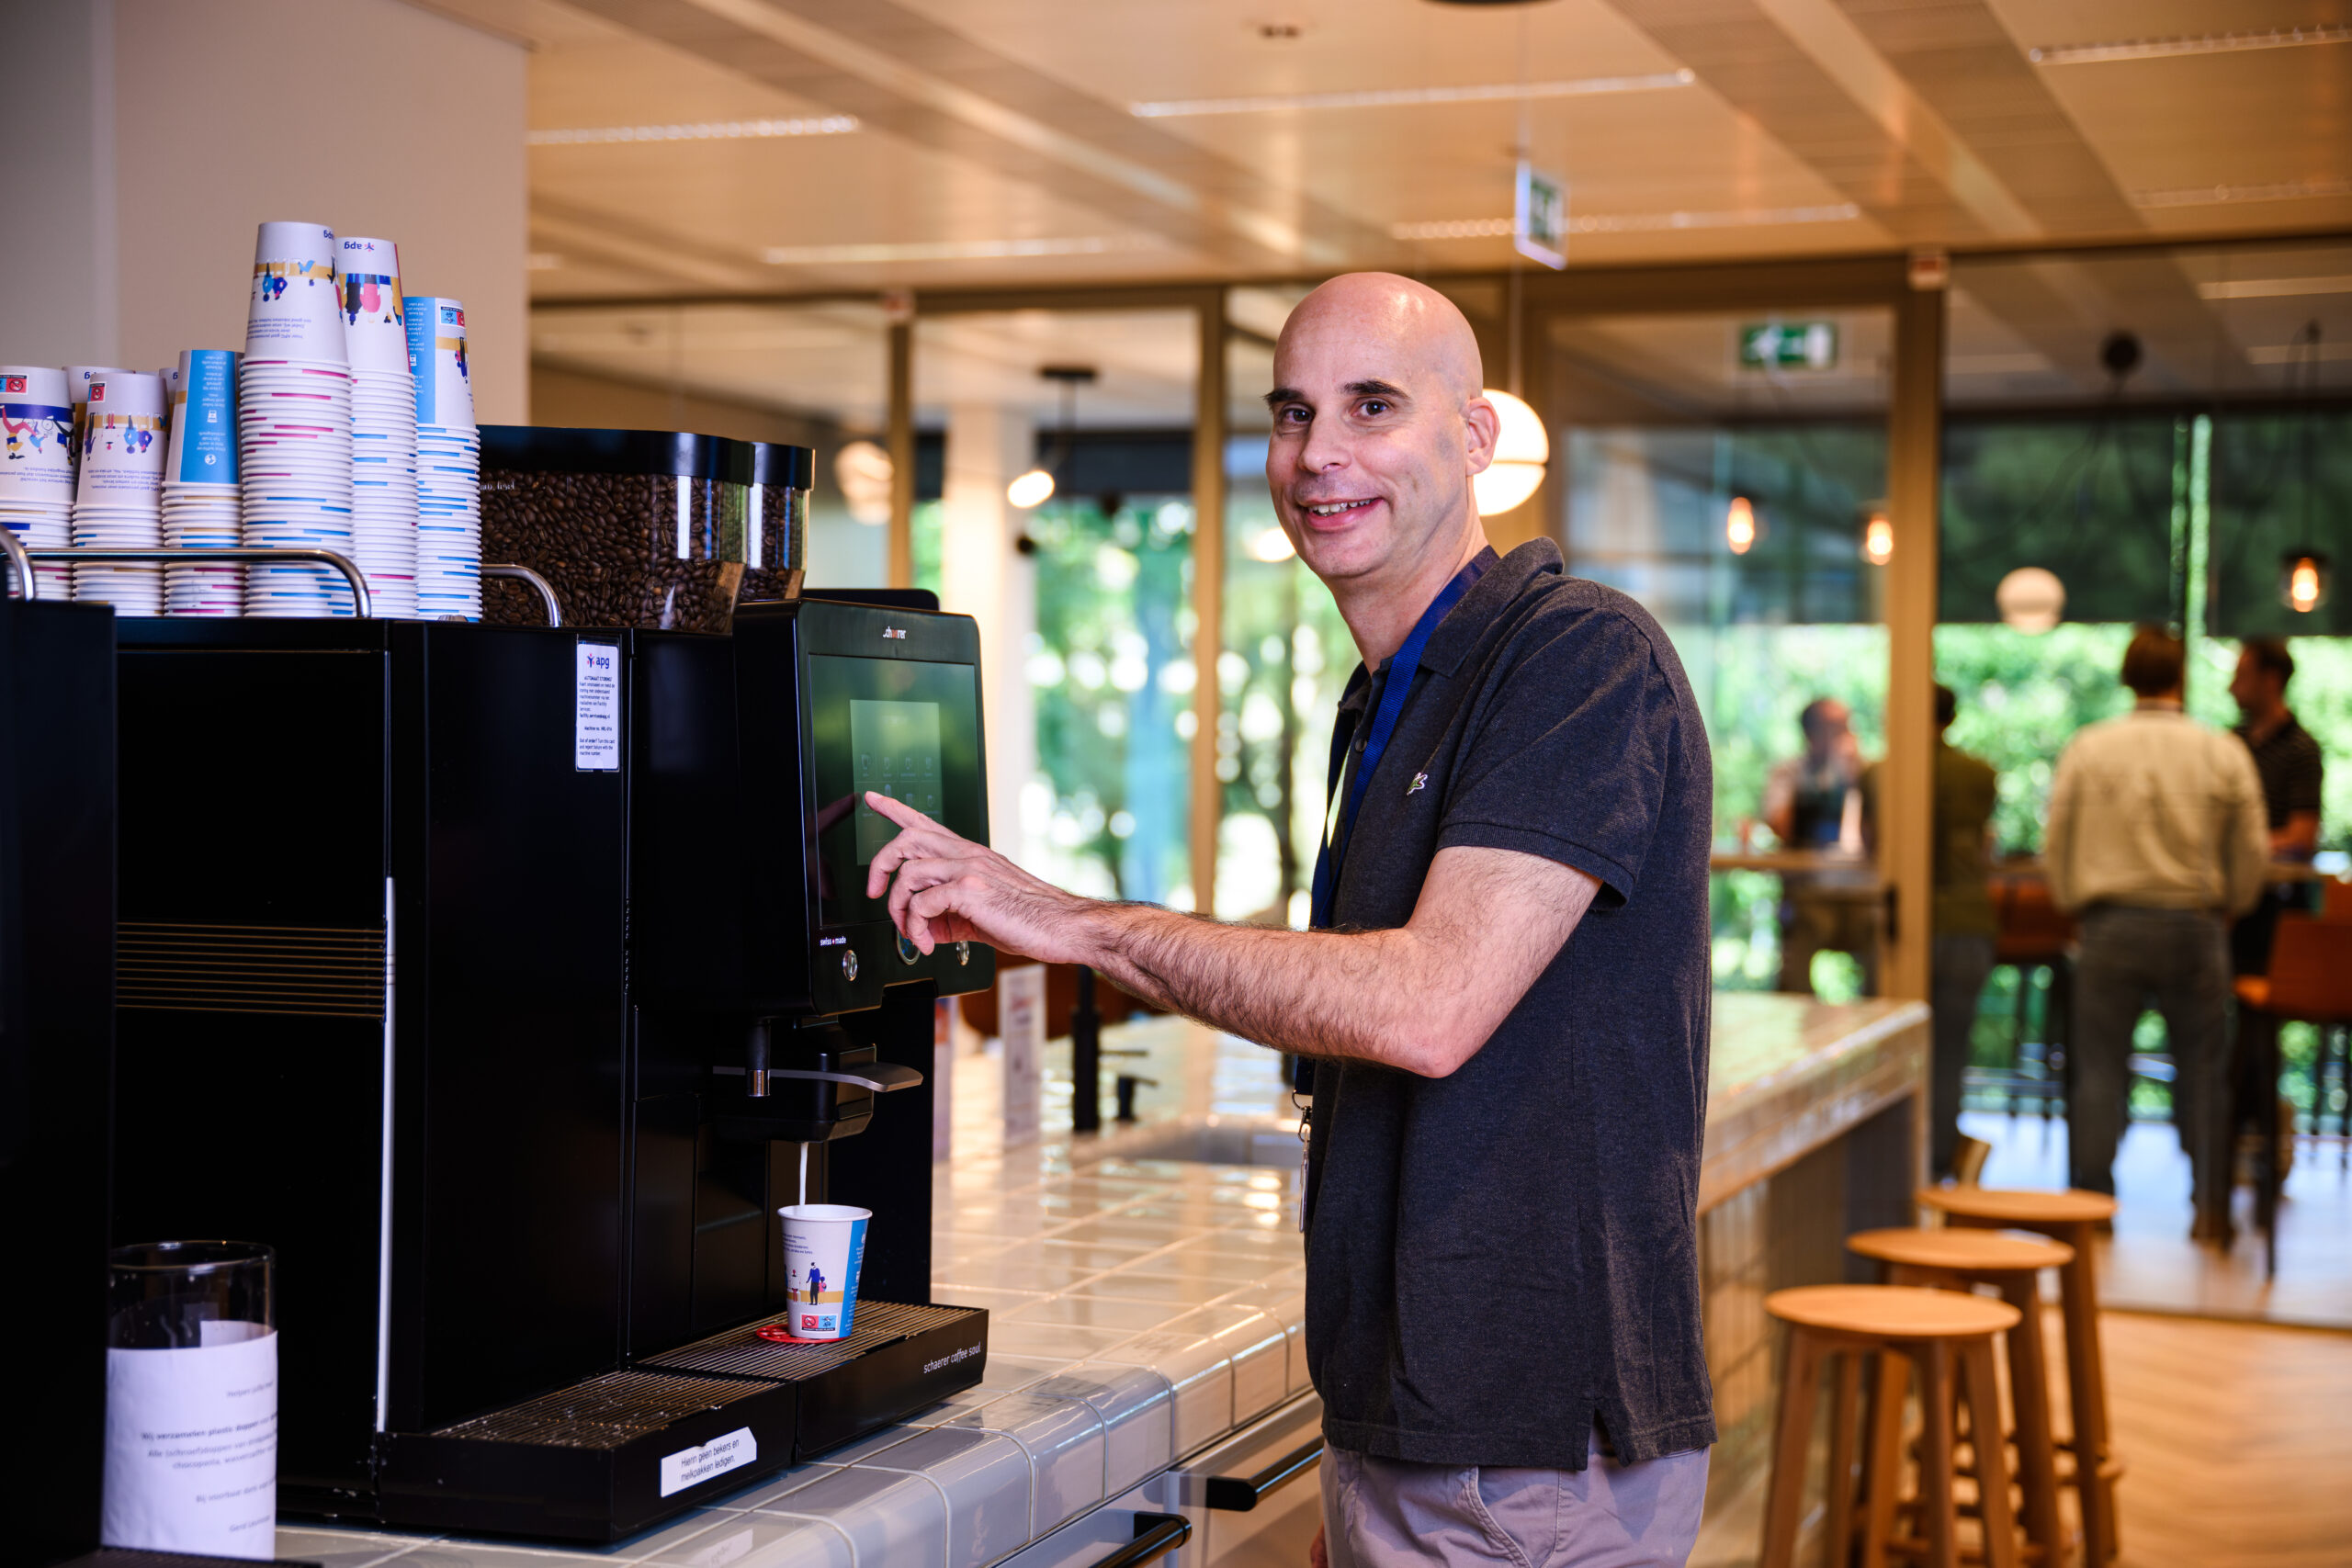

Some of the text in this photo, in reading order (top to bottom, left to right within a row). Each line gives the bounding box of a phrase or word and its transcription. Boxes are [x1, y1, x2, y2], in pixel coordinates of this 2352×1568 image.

[344, 241, 362, 250] apg
[596, 656, 610, 669] apg
[820, 936, 847, 946] swiss made
[923, 1341, 981, 1374] schaerer coffee soul
[698, 1449, 712, 1463] geen
[713, 1443, 731, 1455] bekers
[732, 1439, 739, 1448] en
[681, 1462, 713, 1481] melkpakken
